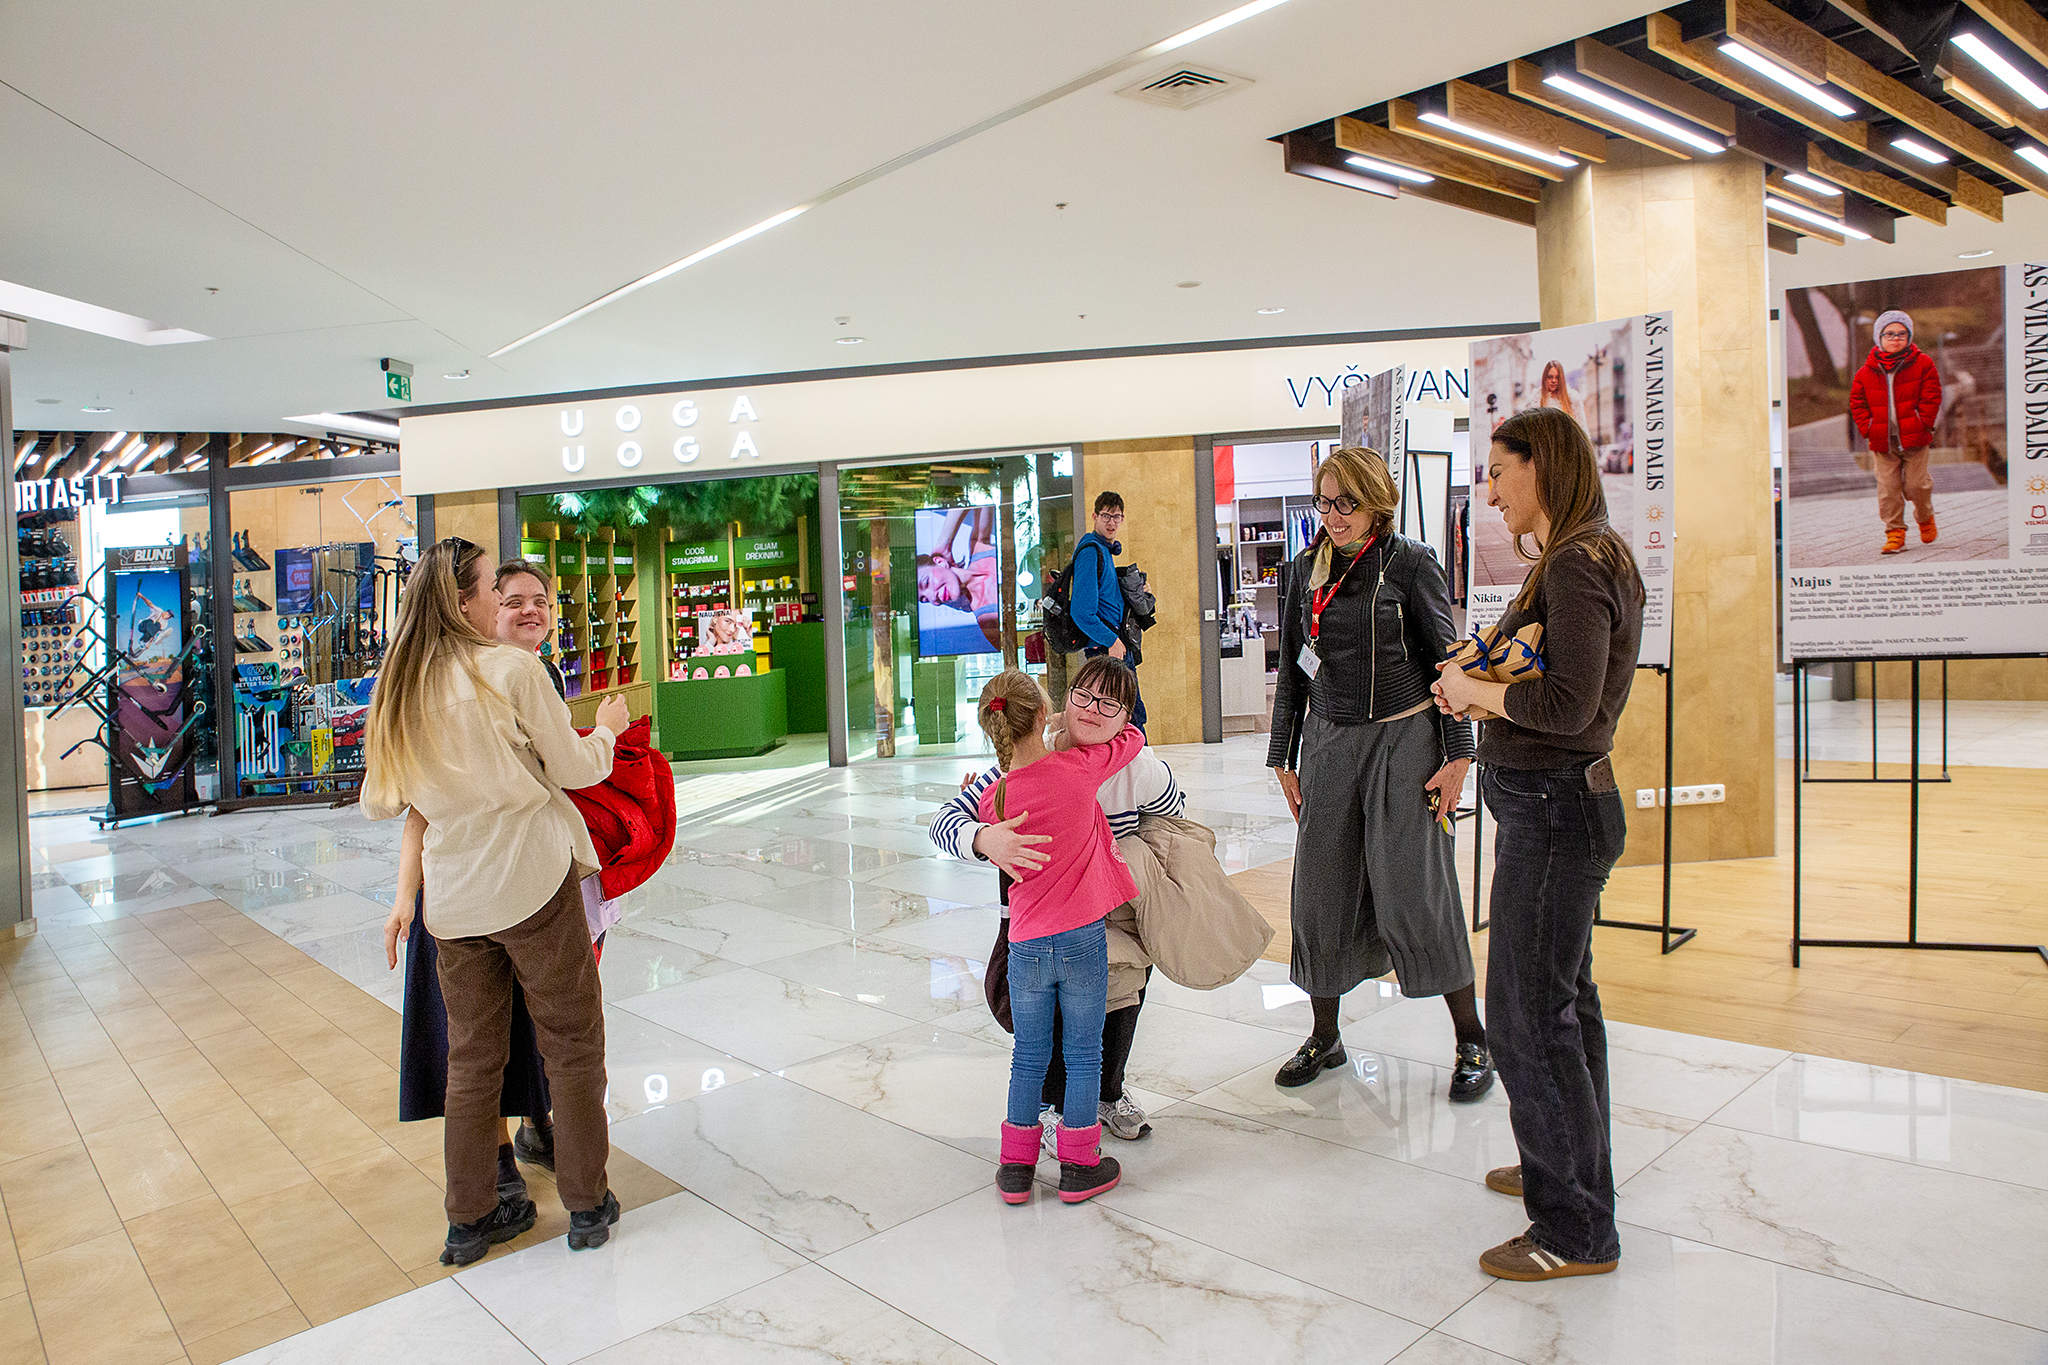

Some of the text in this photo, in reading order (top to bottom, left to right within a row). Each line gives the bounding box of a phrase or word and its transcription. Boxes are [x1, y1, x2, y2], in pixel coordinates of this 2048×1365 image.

[1645, 315, 1668, 337] AŠ
[2024, 300, 2048, 395] VILNIAUS
[1645, 347, 1664, 433] VILNIAUS
[560, 395, 758, 437] UOGA
[1392, 394, 1403, 465] VILNIAUS
[2025, 402, 2048, 460] DALIS
[562, 431, 759, 473] UOGA
[1646, 438, 1665, 491] DALIS
[672, 555, 718, 566] STANGRINIMUI
[684, 546, 705, 555] ODOS
[754, 543, 778, 551] GILIAM
[1473, 594, 1503, 603] Nikita
[1790, 576, 1832, 590] Majus
